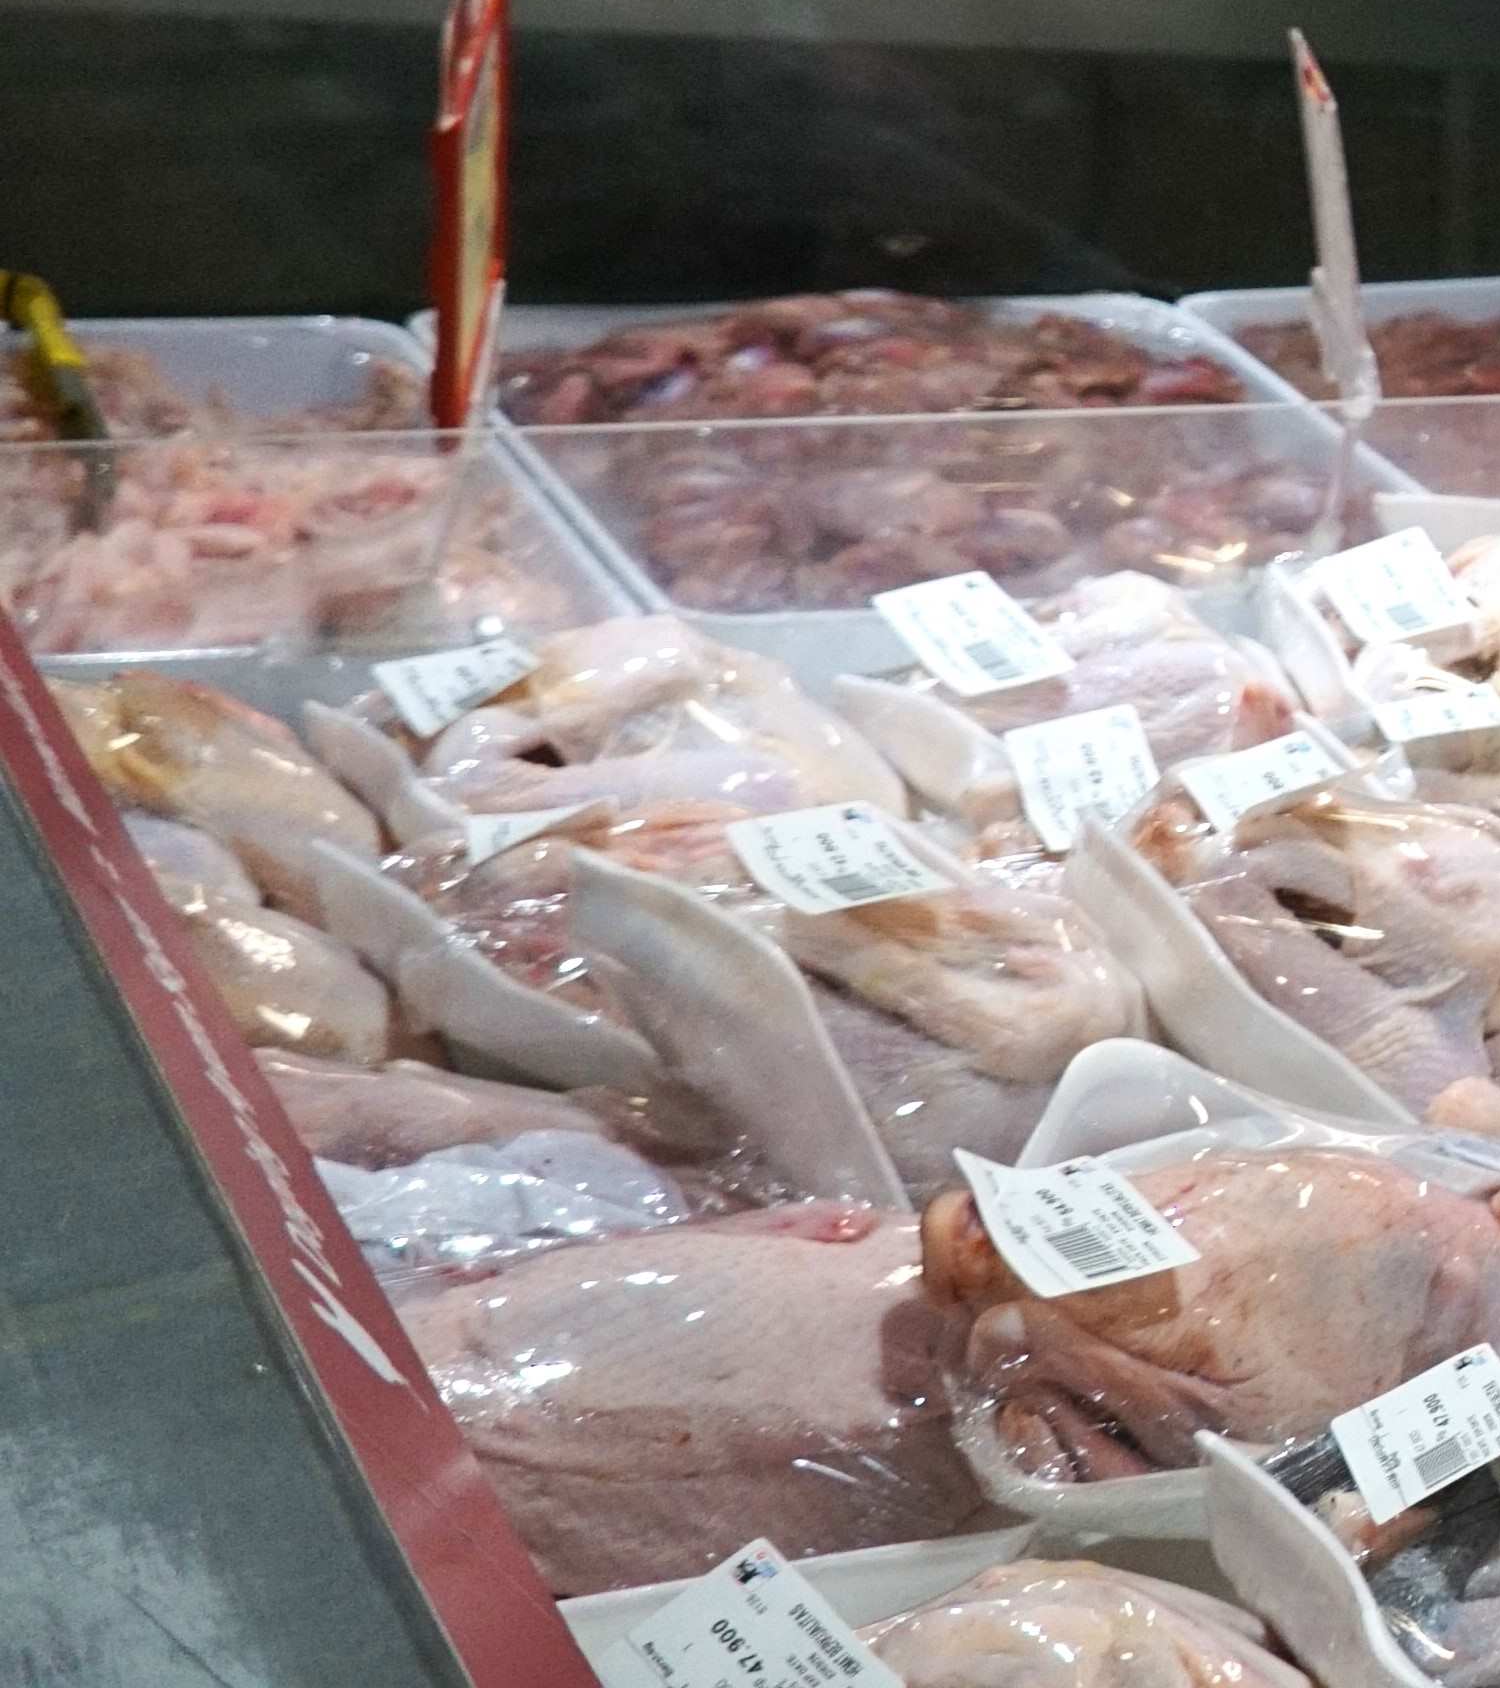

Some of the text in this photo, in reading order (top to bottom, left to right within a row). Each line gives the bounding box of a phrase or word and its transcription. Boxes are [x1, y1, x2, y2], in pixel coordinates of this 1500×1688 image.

[1422, 1391, 1450, 1428] 47.900
[709, 1618, 763, 1674] 47.900
[787, 1602, 843, 1658] BERKUALITAS
